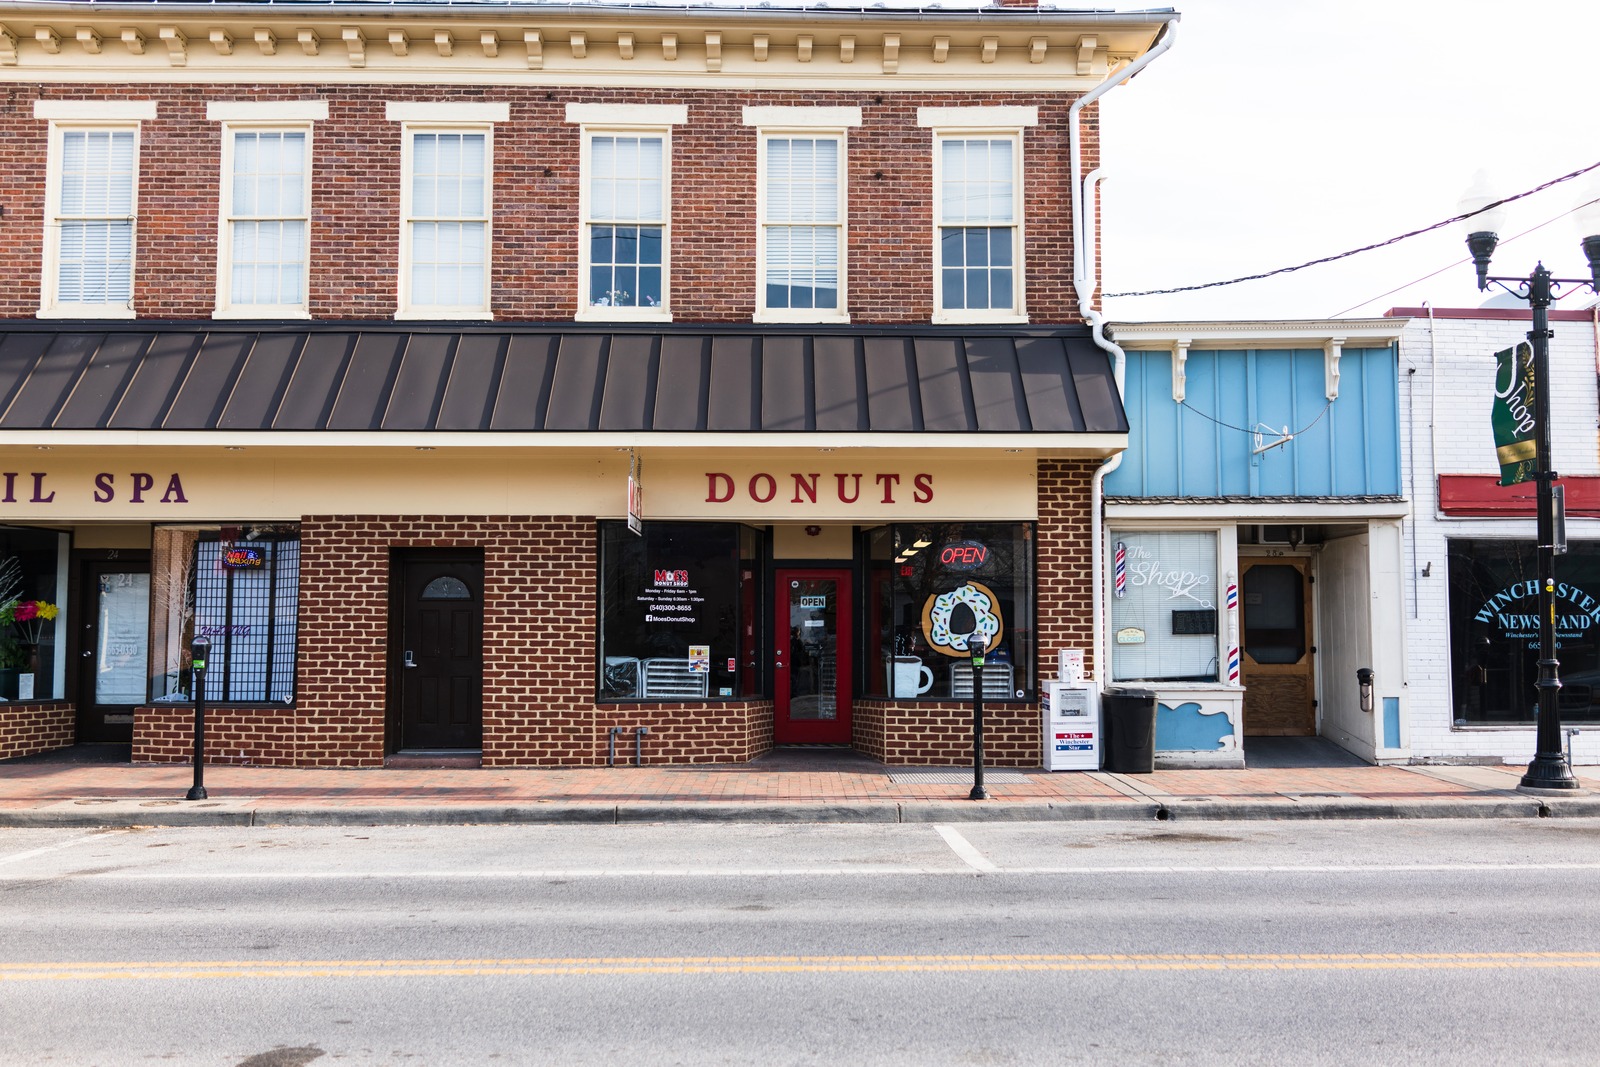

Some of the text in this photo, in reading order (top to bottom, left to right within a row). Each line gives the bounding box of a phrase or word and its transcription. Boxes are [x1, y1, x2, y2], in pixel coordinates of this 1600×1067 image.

[1, 472, 189, 503] IL SPA
[705, 472, 934, 504] DONUTS
[107, 549, 119, 560] 24
[226, 551, 247, 559] Nail
[941, 546, 987, 564] OPEN
[1127, 545, 1153, 559] The
[117, 573, 133, 587] 24
[655, 570, 688, 582] MOE'S
[1130, 560, 1198, 595] Shop
[801, 597, 825, 607] OPEN
[1498, 613, 1591, 629] NEWSTAND
